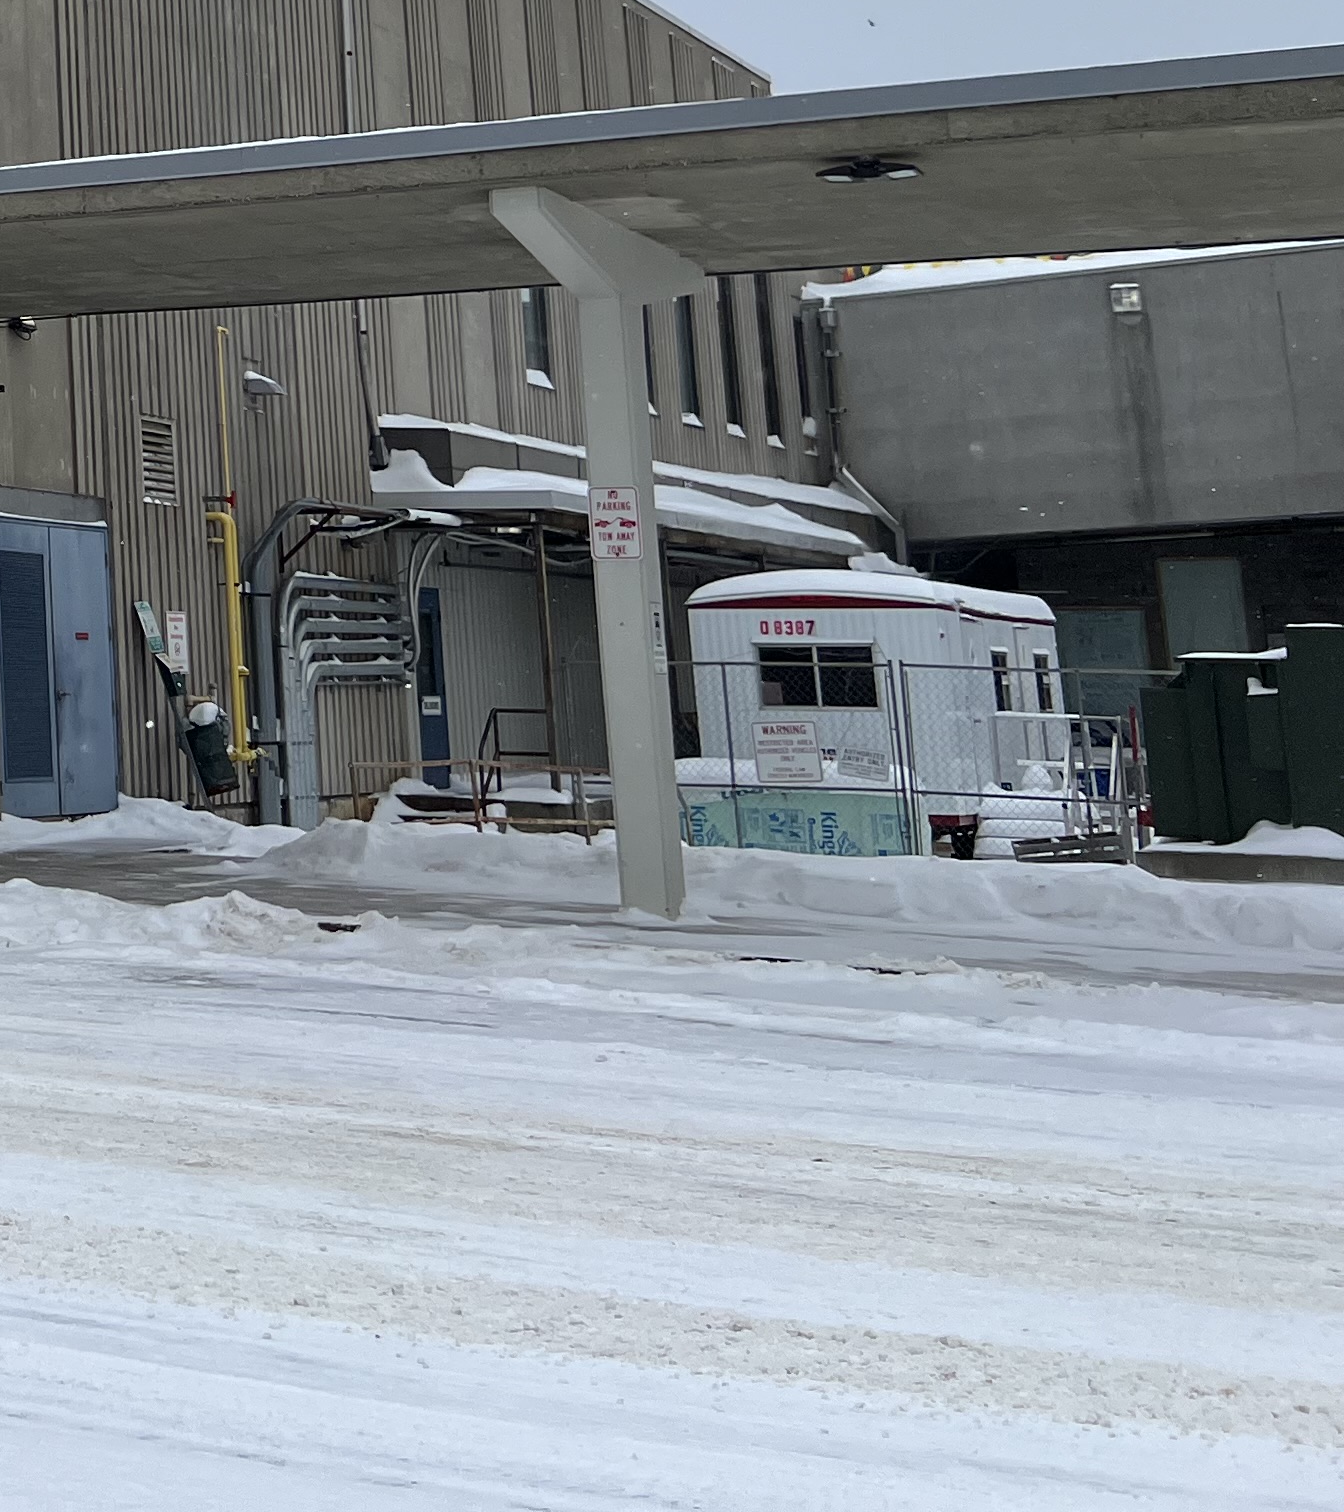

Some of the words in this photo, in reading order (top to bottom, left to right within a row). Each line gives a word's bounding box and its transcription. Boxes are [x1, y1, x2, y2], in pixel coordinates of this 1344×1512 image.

[596, 501, 631, 511] PARKING
[598, 532, 612, 541] TOW
[617, 532, 635, 541] AWAY
[607, 545, 627, 555] ZONE
[761, 725, 807, 735] WARNING
